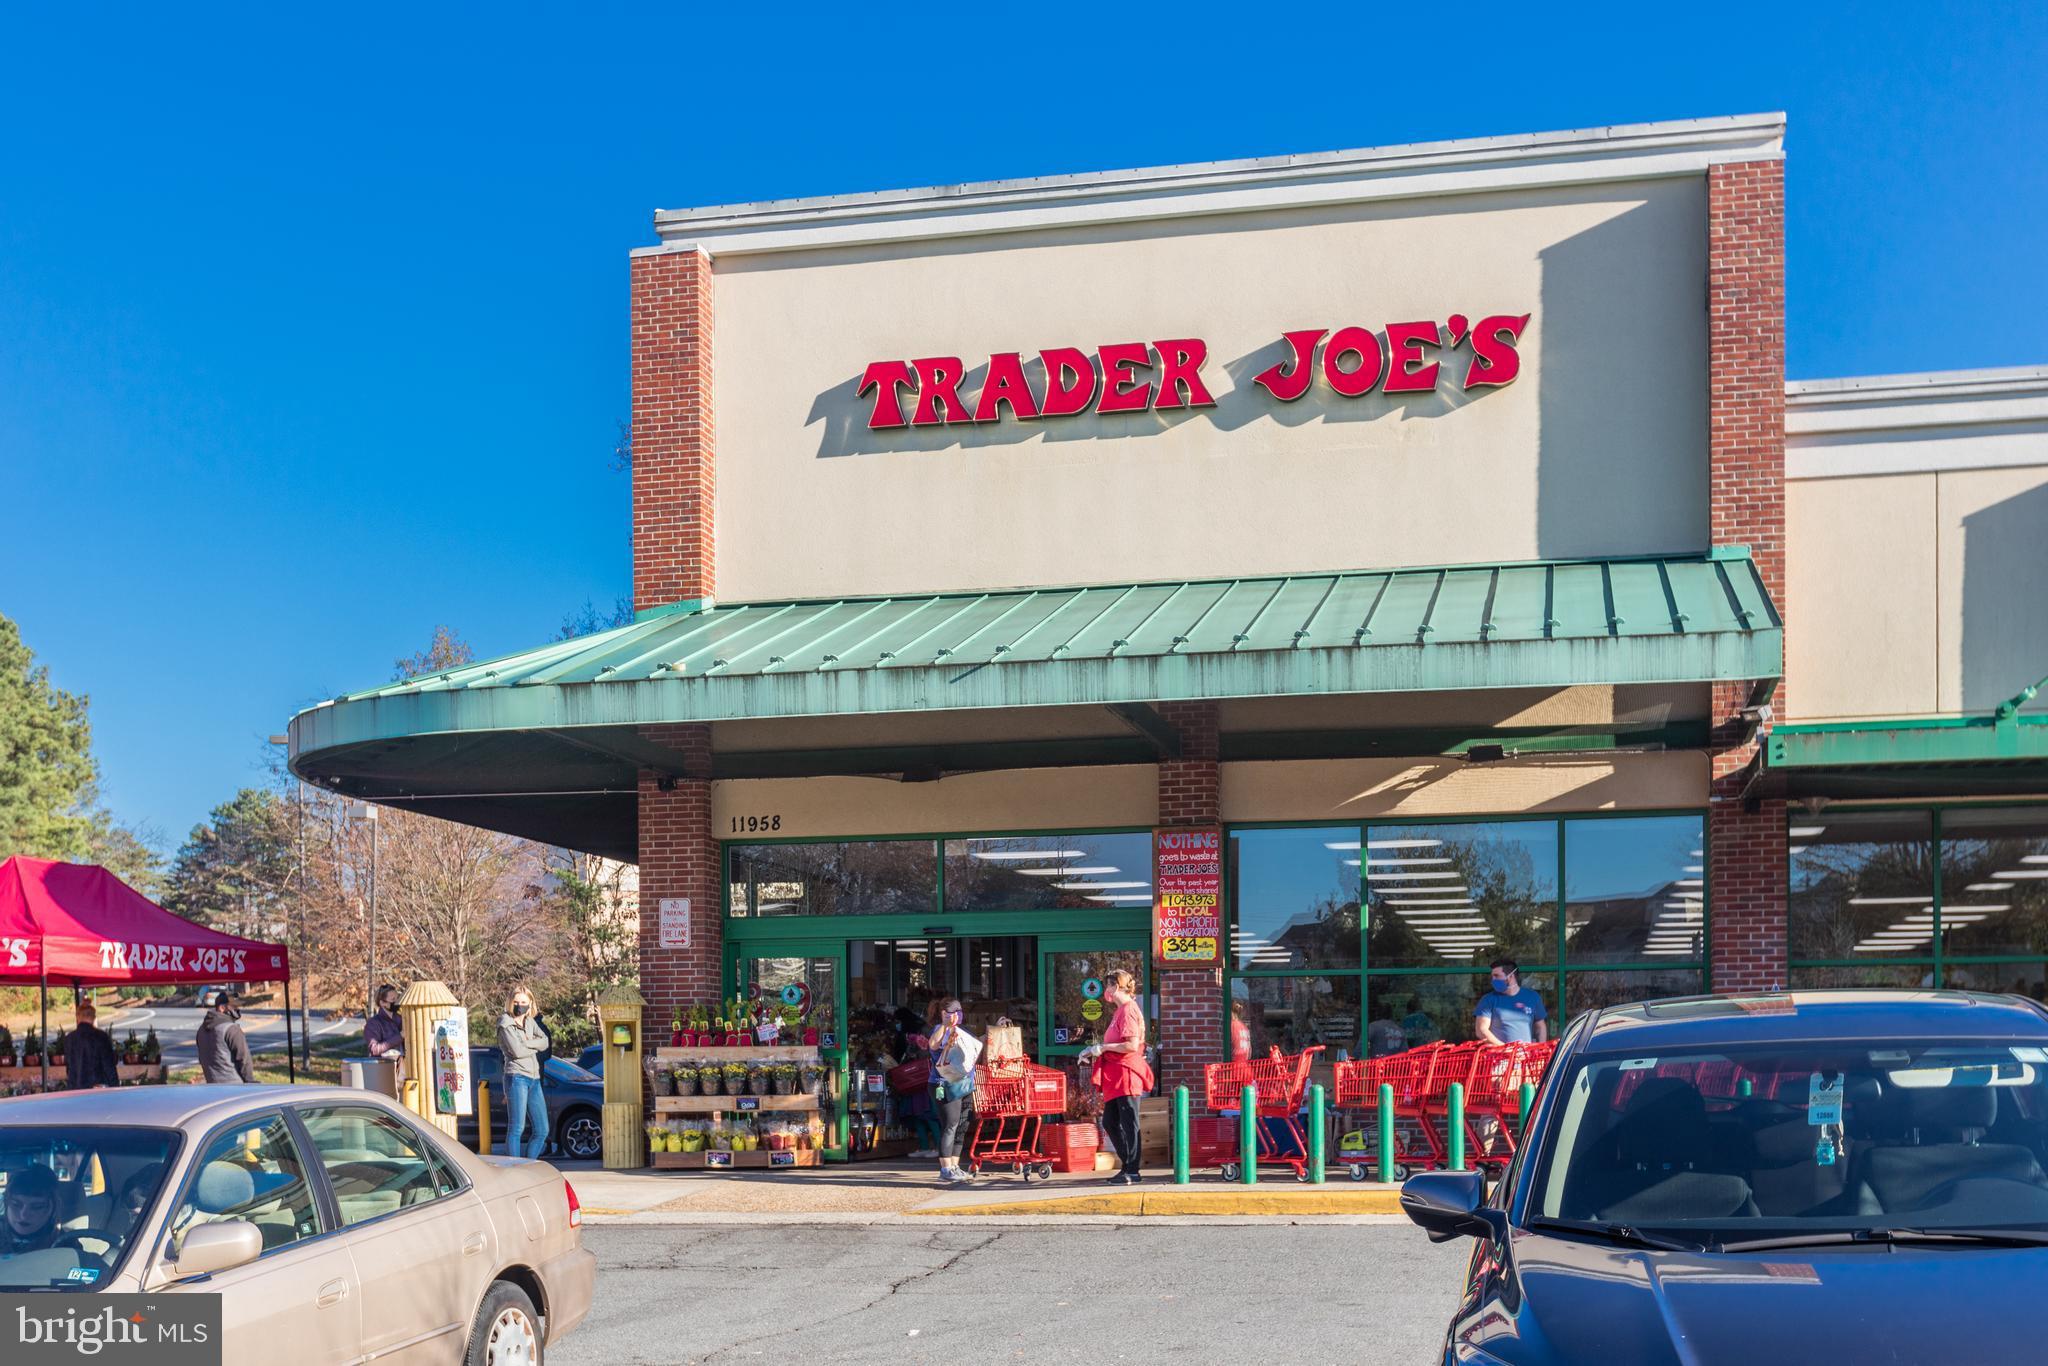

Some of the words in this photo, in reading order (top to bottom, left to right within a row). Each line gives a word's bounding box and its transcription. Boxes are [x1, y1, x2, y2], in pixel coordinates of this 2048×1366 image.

[856, 338, 1218, 430] TRADER
[1252, 313, 1531, 403] JOE'S
[731, 815, 781, 832] 11958
[1159, 833, 1218, 849] NOTHING
[1159, 854, 1179, 864] goes
[1180, 850, 1188, 861] to
[1189, 850, 1210, 860] waste
[1211, 850, 1218, 860] at
[1160, 864, 1196, 875] TRADER
[1159, 878, 1176, 887] Over
[1177, 878, 1187, 886] the
[1188, 878, 1203, 887] past
[1183, 886, 1195, 894] has
[1197, 886, 1218, 894] shared
[1167, 907, 1177, 916] to
[1179, 906, 1213, 916] LOCAL
[662, 930, 673, 938] FIRE
[674, 930, 687, 938] LANE
[1167, 938, 1197, 952] 384
[98, 941, 185, 972] TRADER
[188, 946, 248, 974] JOE'S
